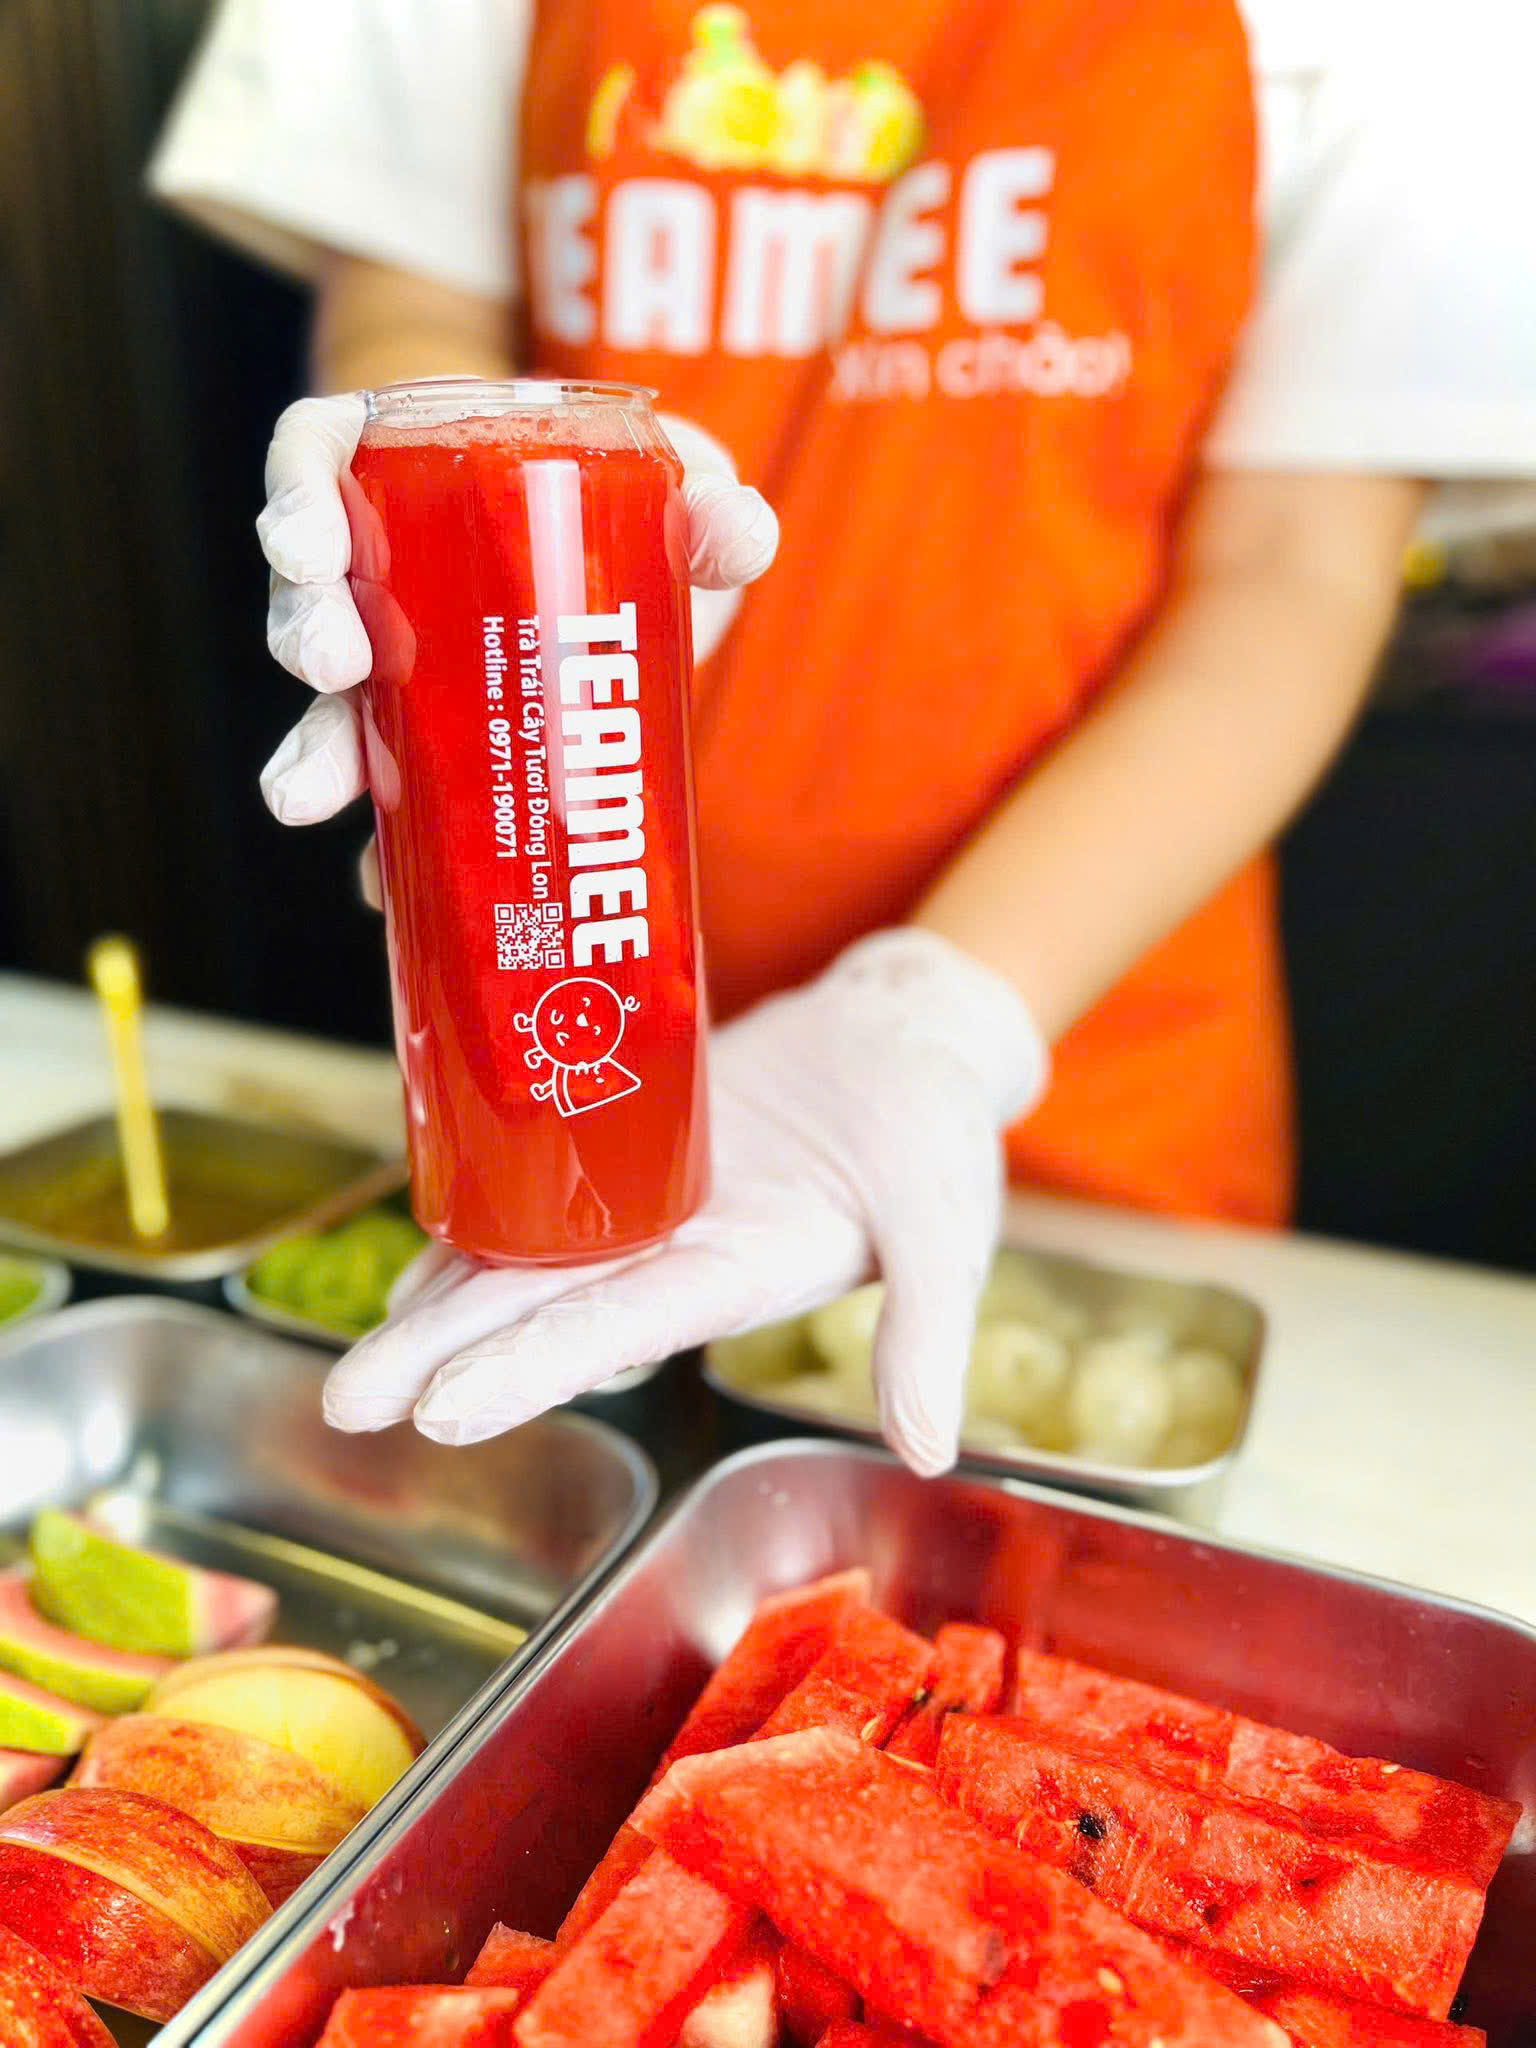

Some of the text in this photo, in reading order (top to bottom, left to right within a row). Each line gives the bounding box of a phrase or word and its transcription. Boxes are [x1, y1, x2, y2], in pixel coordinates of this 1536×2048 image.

[526, 146, 1056, 358] EAMEE
[482, 616, 508, 700] Hotline
[517, 615, 552, 900] Trà Trái Cây Tươi Đóng Lon
[488, 718, 518, 858] 0971-190071
[557, 602, 649, 967] TEAMEE
